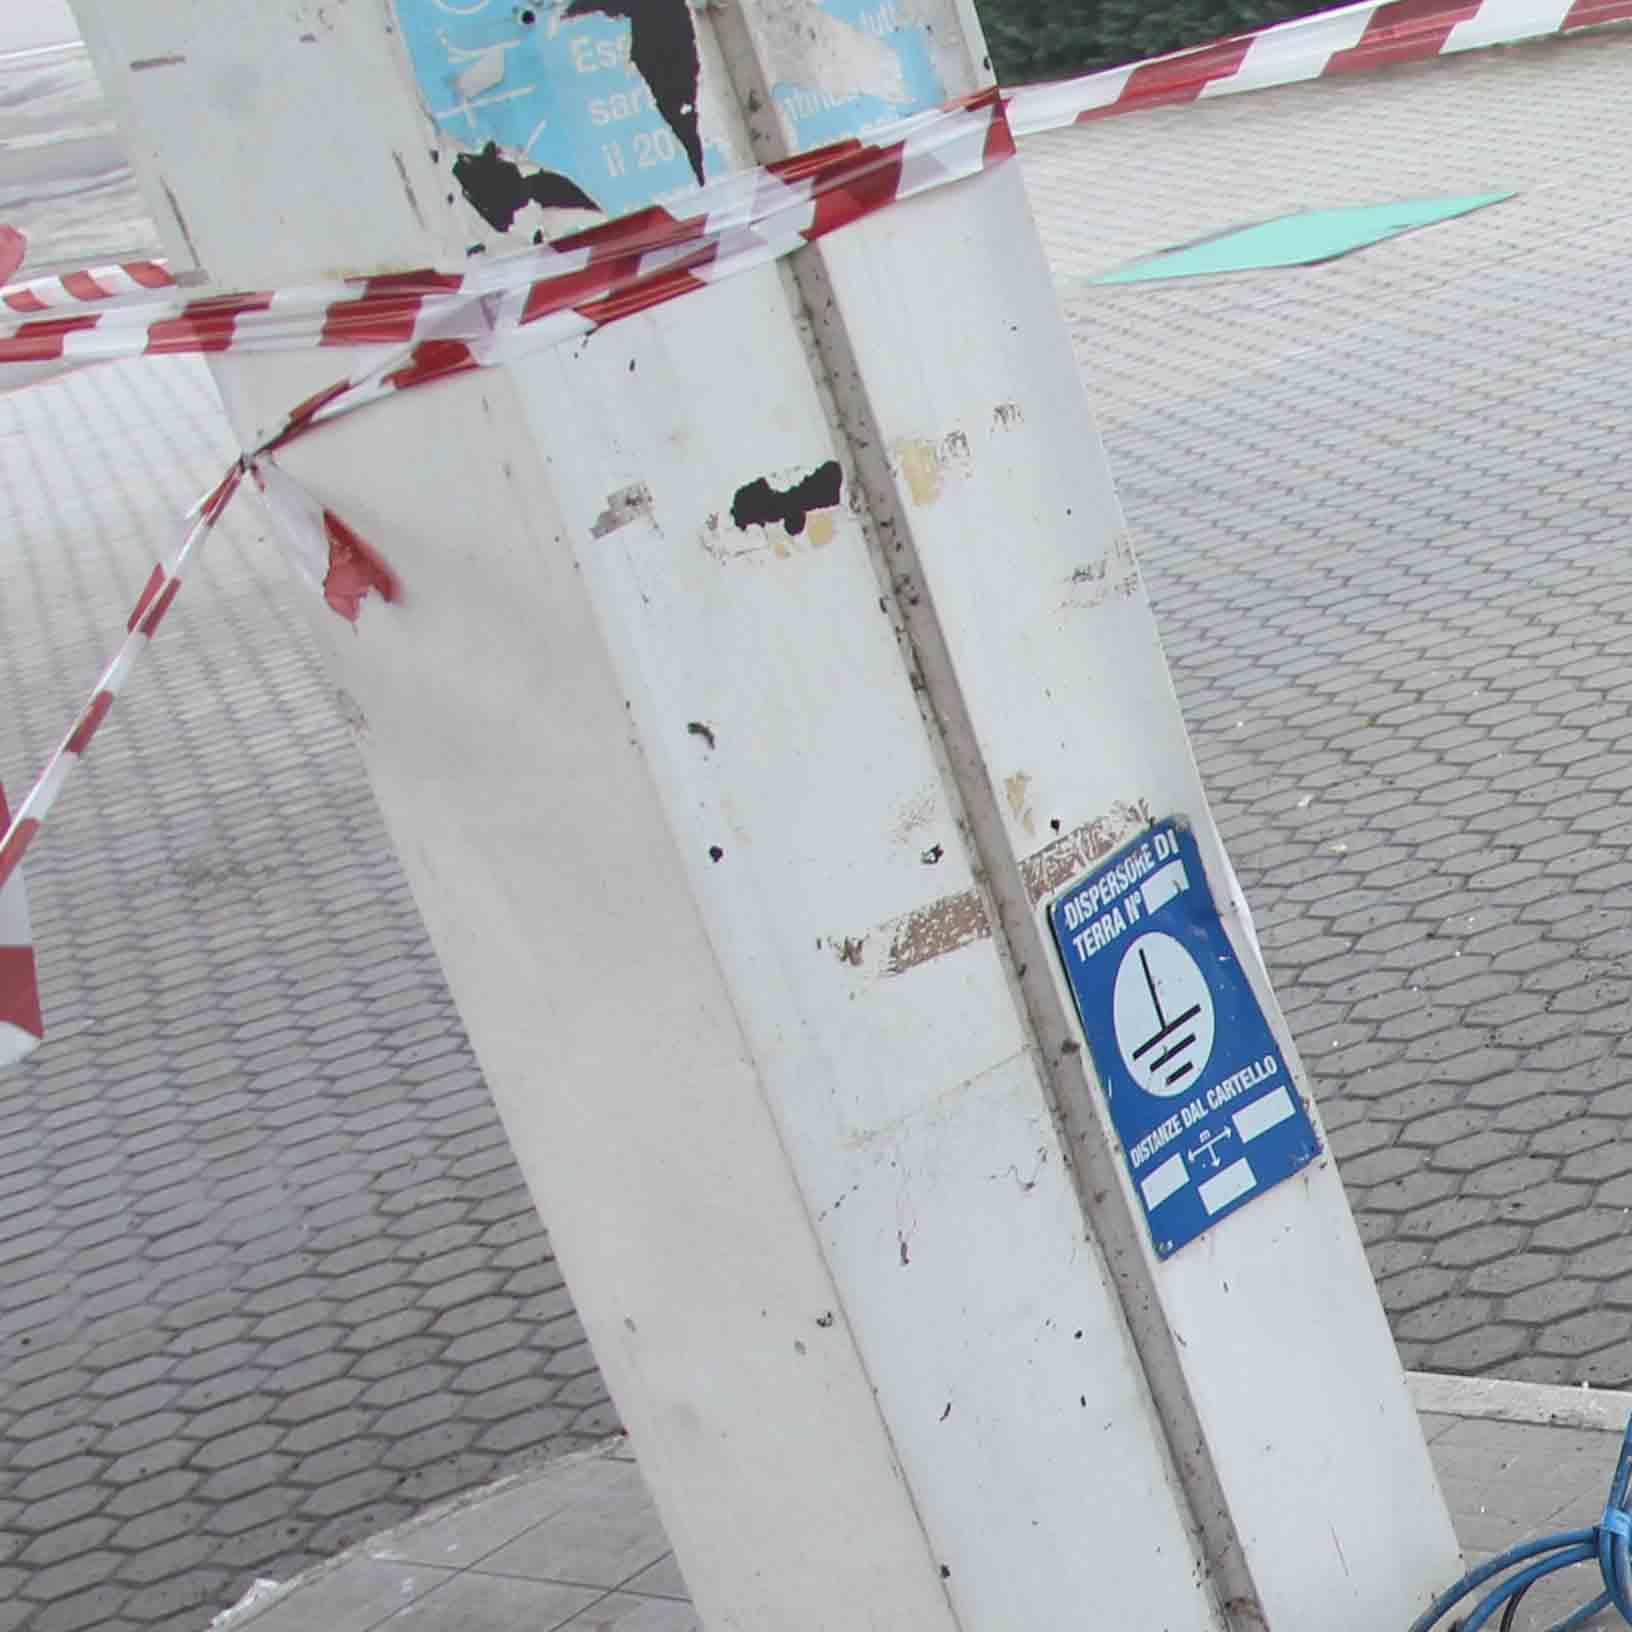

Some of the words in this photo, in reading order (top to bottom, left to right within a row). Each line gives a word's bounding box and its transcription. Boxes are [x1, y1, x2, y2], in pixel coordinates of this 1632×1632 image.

[1063, 842, 1156, 932] DISPERSORE
[1153, 828, 1180, 861] DI
[1072, 906, 1127, 963] TERRA
[1130, 1113, 1183, 1168] DISTANZE
[1180, 1098, 1209, 1129] DAL
[1206, 1055, 1278, 1110] CARTELLO
